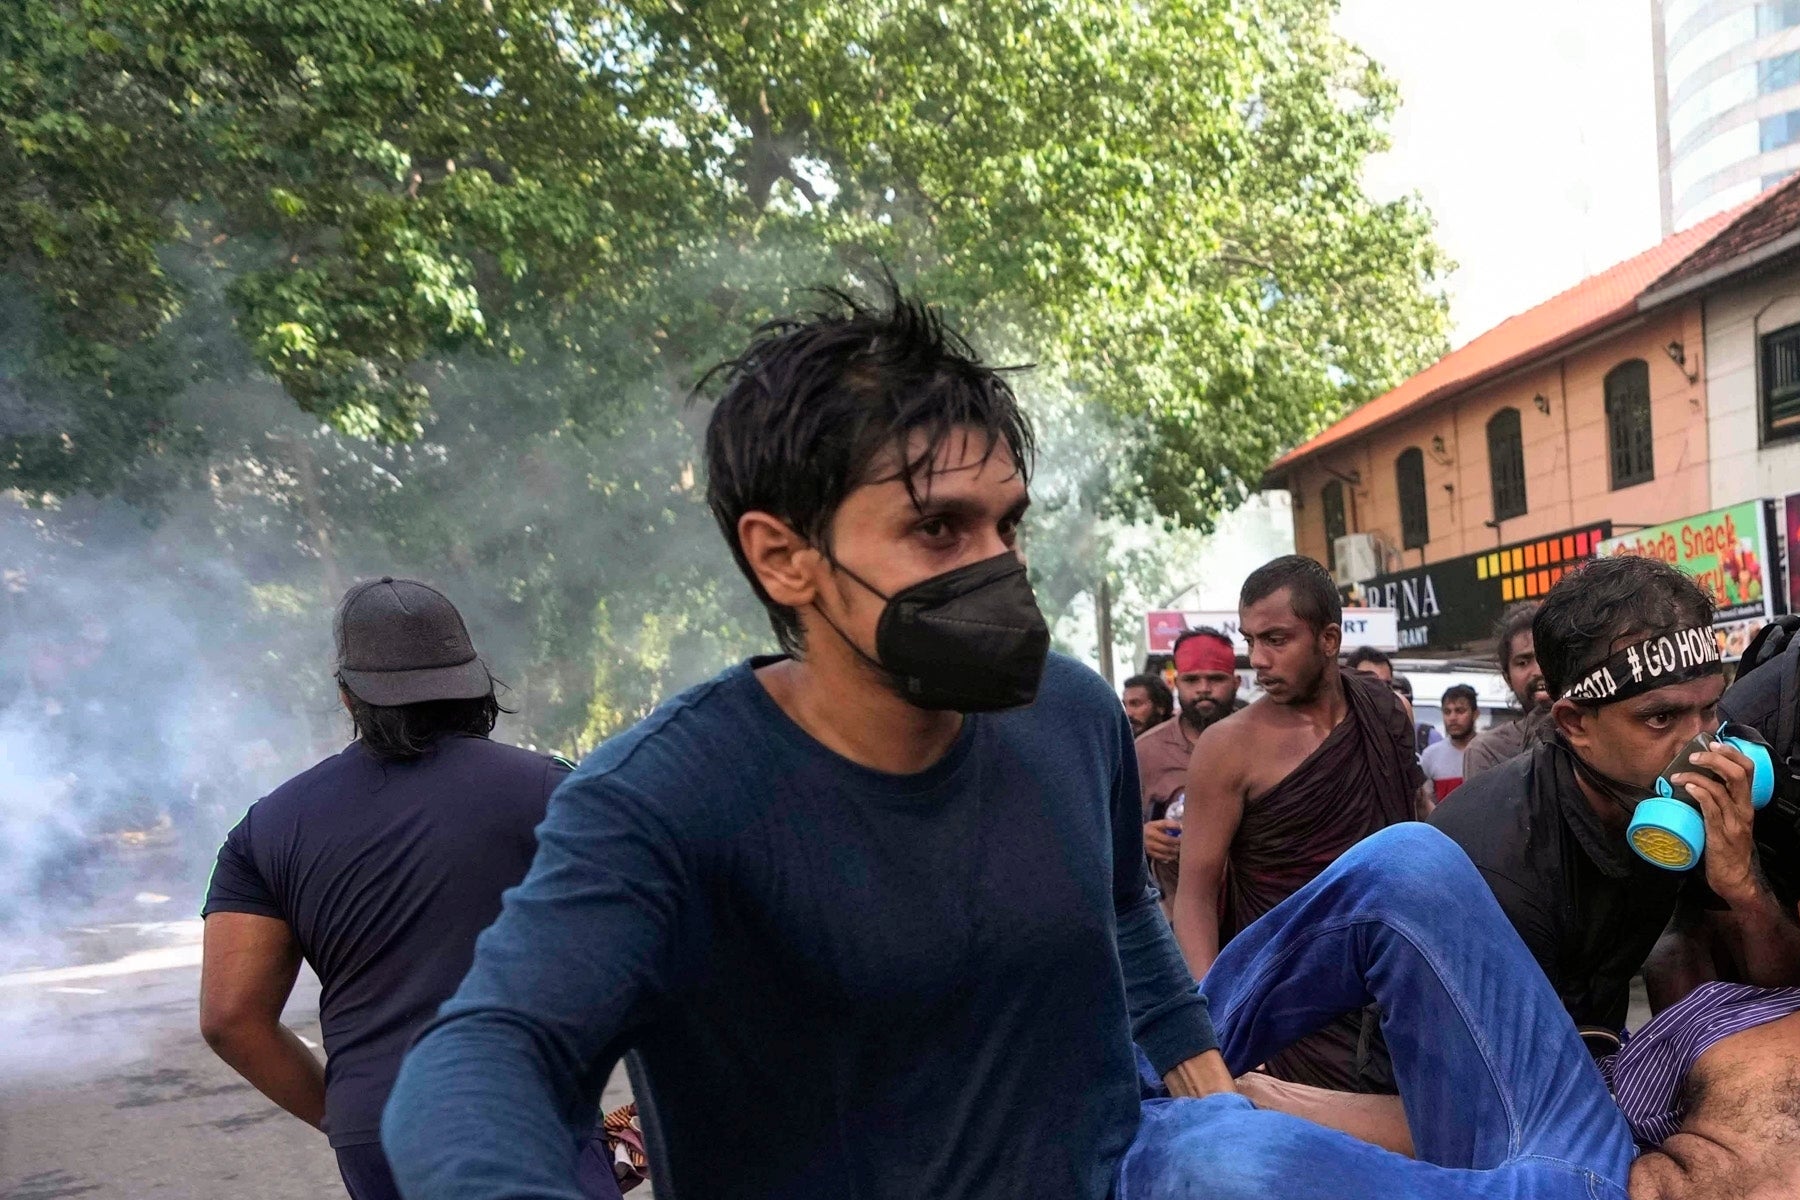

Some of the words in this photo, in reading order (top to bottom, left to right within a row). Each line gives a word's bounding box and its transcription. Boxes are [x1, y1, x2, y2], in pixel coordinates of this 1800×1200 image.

[1681, 514, 1737, 559] Snack
[1643, 636, 1676, 677] GO
[1675, 625, 1719, 668] HOME
